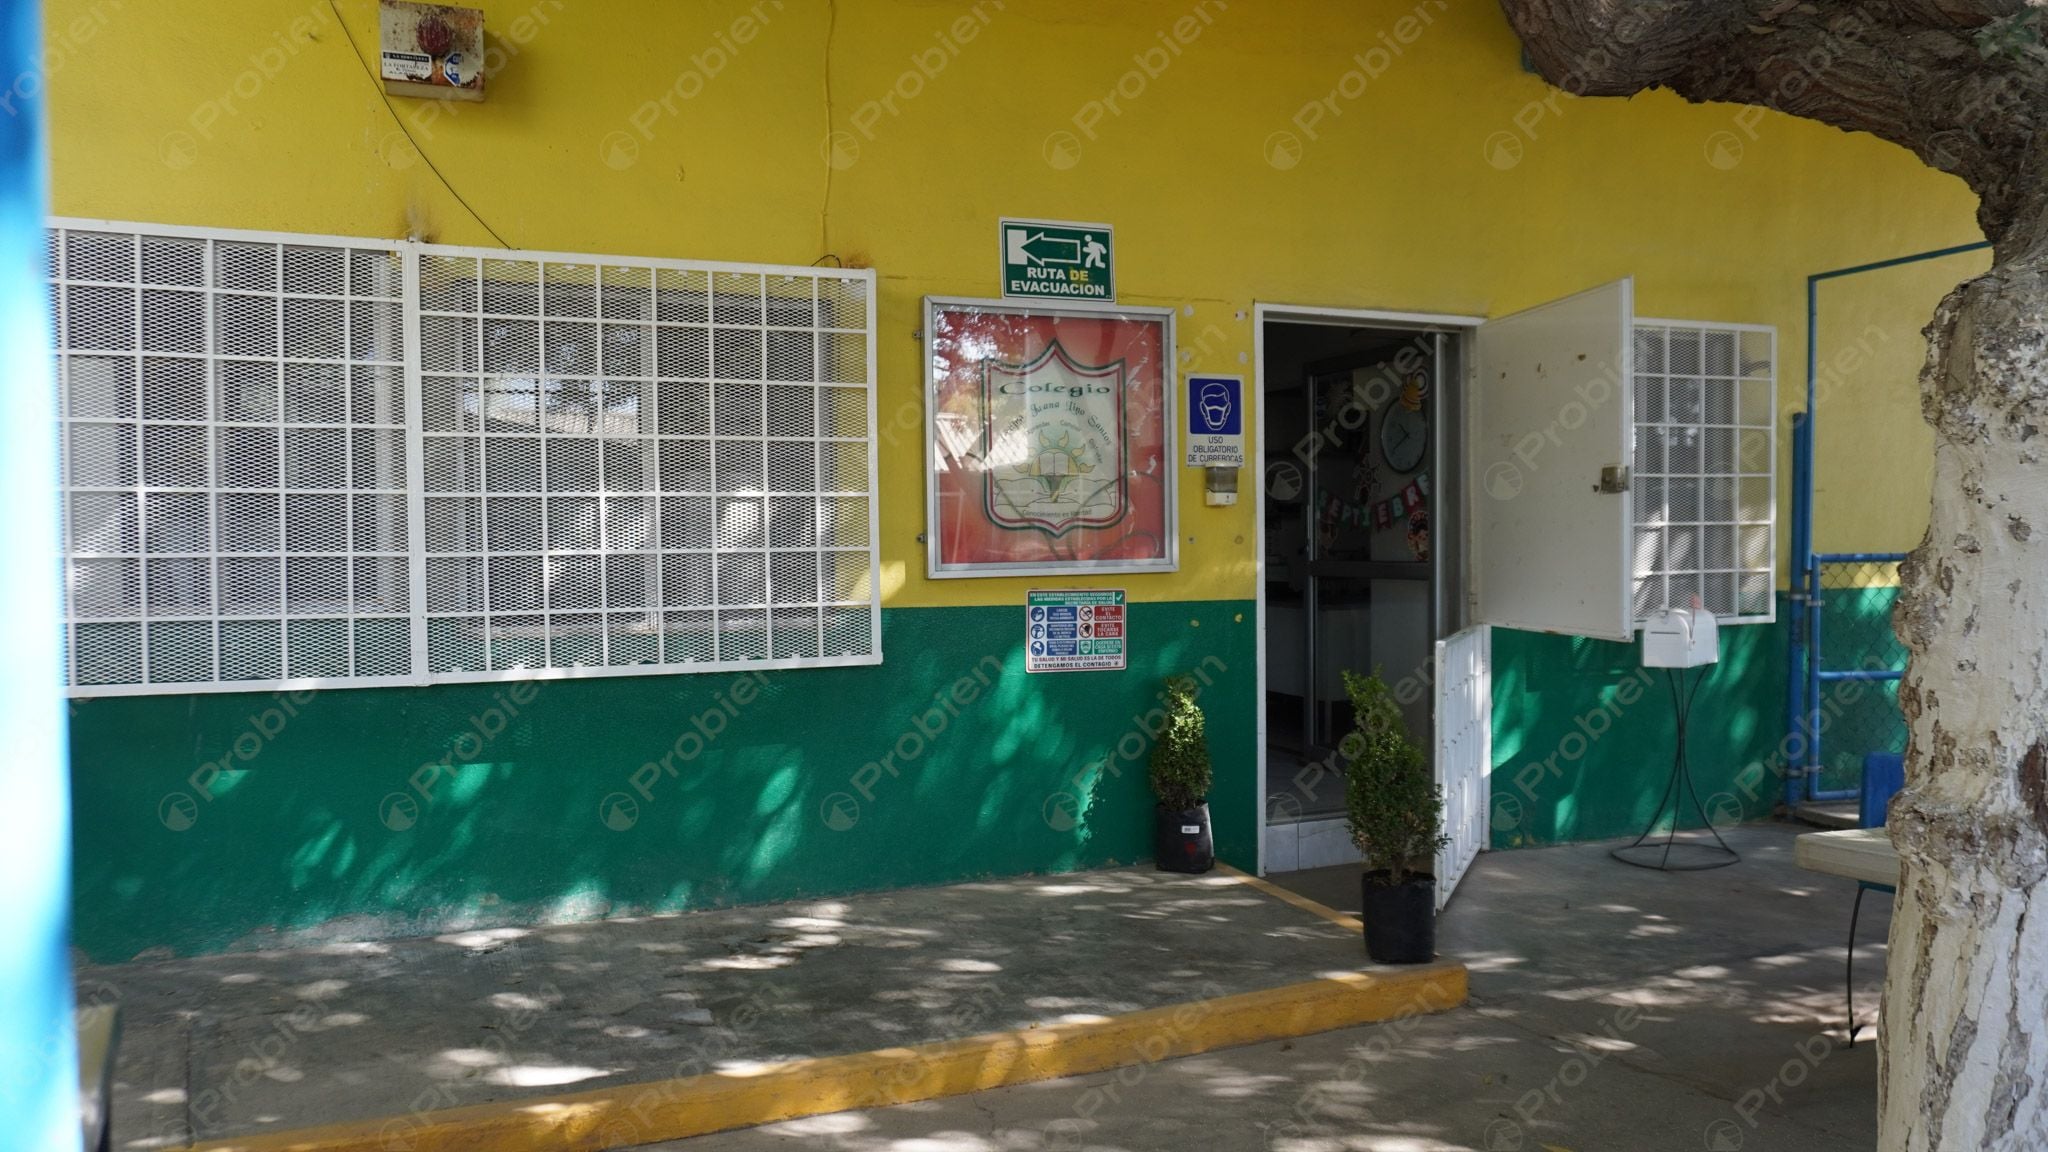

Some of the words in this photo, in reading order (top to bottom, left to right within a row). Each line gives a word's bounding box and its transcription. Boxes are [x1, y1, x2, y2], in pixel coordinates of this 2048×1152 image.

[1027, 267, 1066, 280] RUTA
[1069, 270, 1089, 281] DE
[1011, 280, 1105, 295] EVACUACION
[1000, 381, 1110, 397] Colegio
[1208, 436, 1223, 444] USO
[1193, 445, 1239, 453] OBLIGATORIO
[1188, 454, 1197, 462] DE
